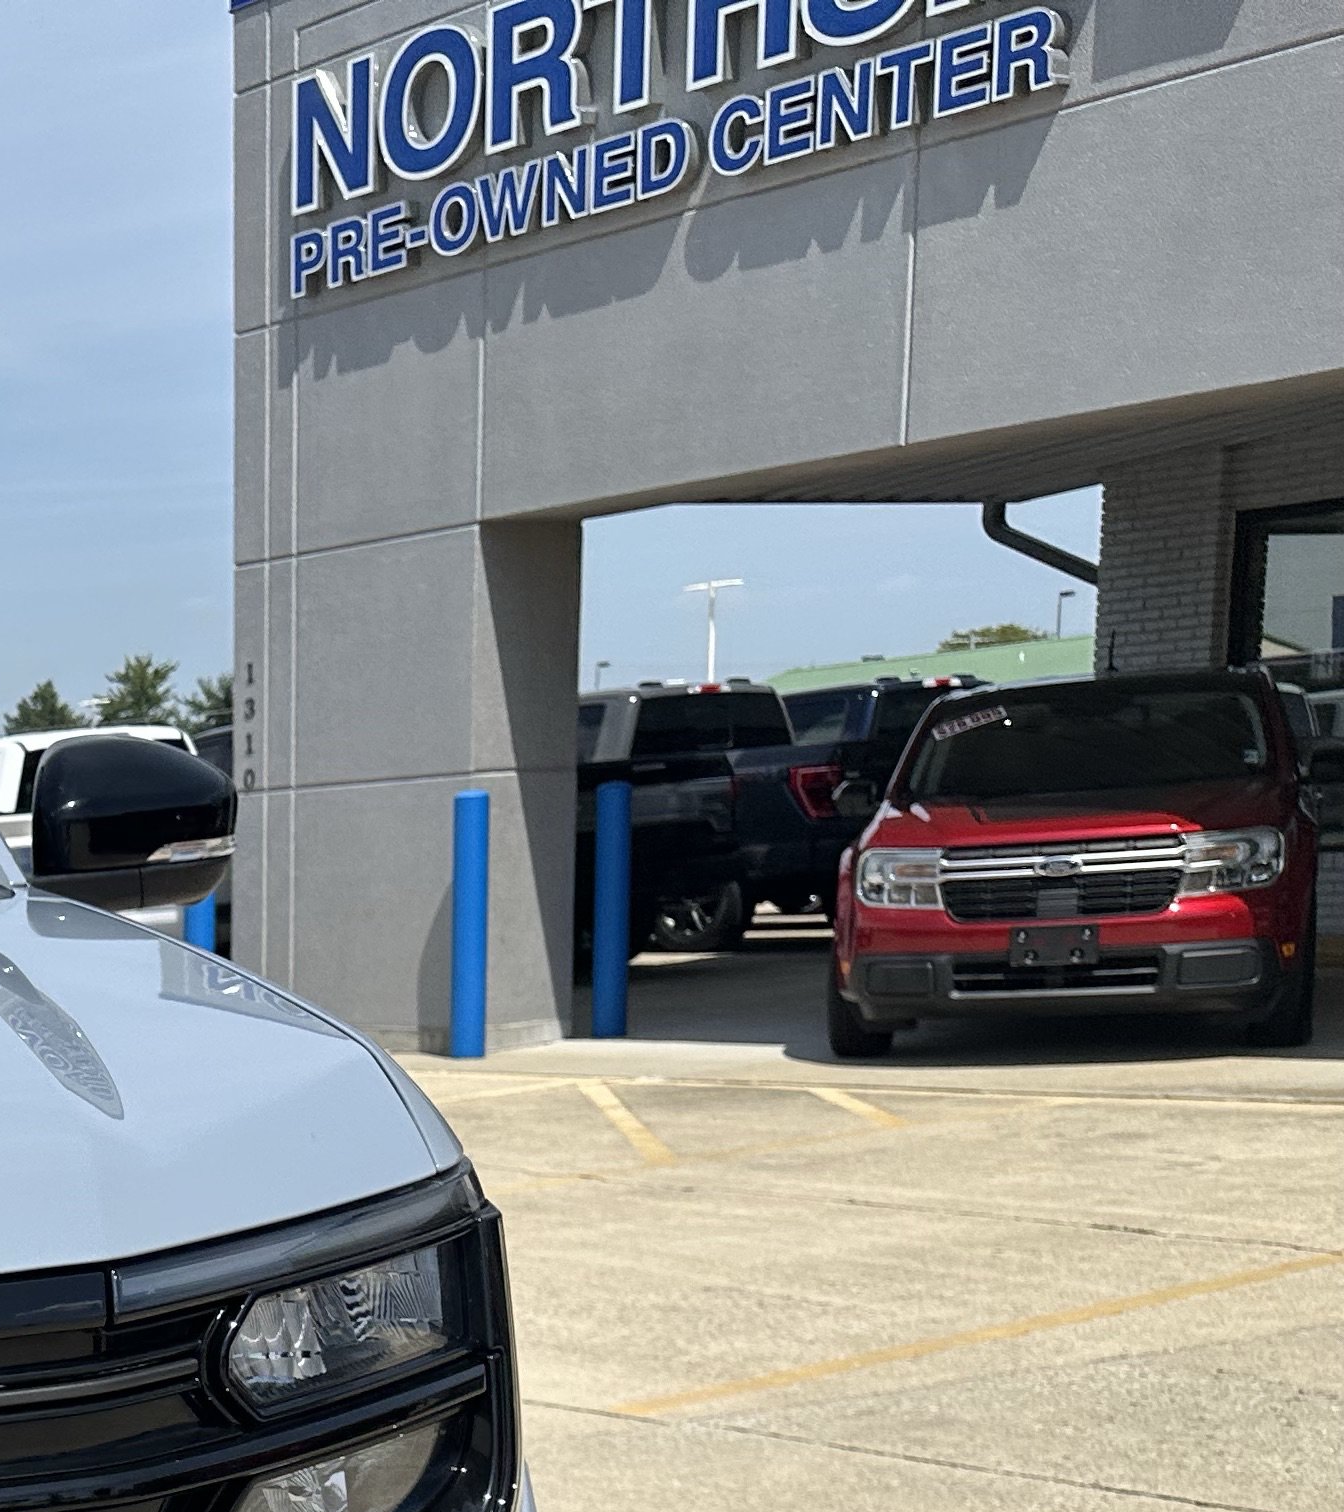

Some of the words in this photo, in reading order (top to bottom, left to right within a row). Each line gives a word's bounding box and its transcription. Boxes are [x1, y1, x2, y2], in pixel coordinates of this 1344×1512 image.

[291, 0, 971, 216] NORTH
[291, 117, 689, 300] PRE-OWNED
[708, 6, 1058, 176] CENTER
[243, 662, 256, 791] 1310
